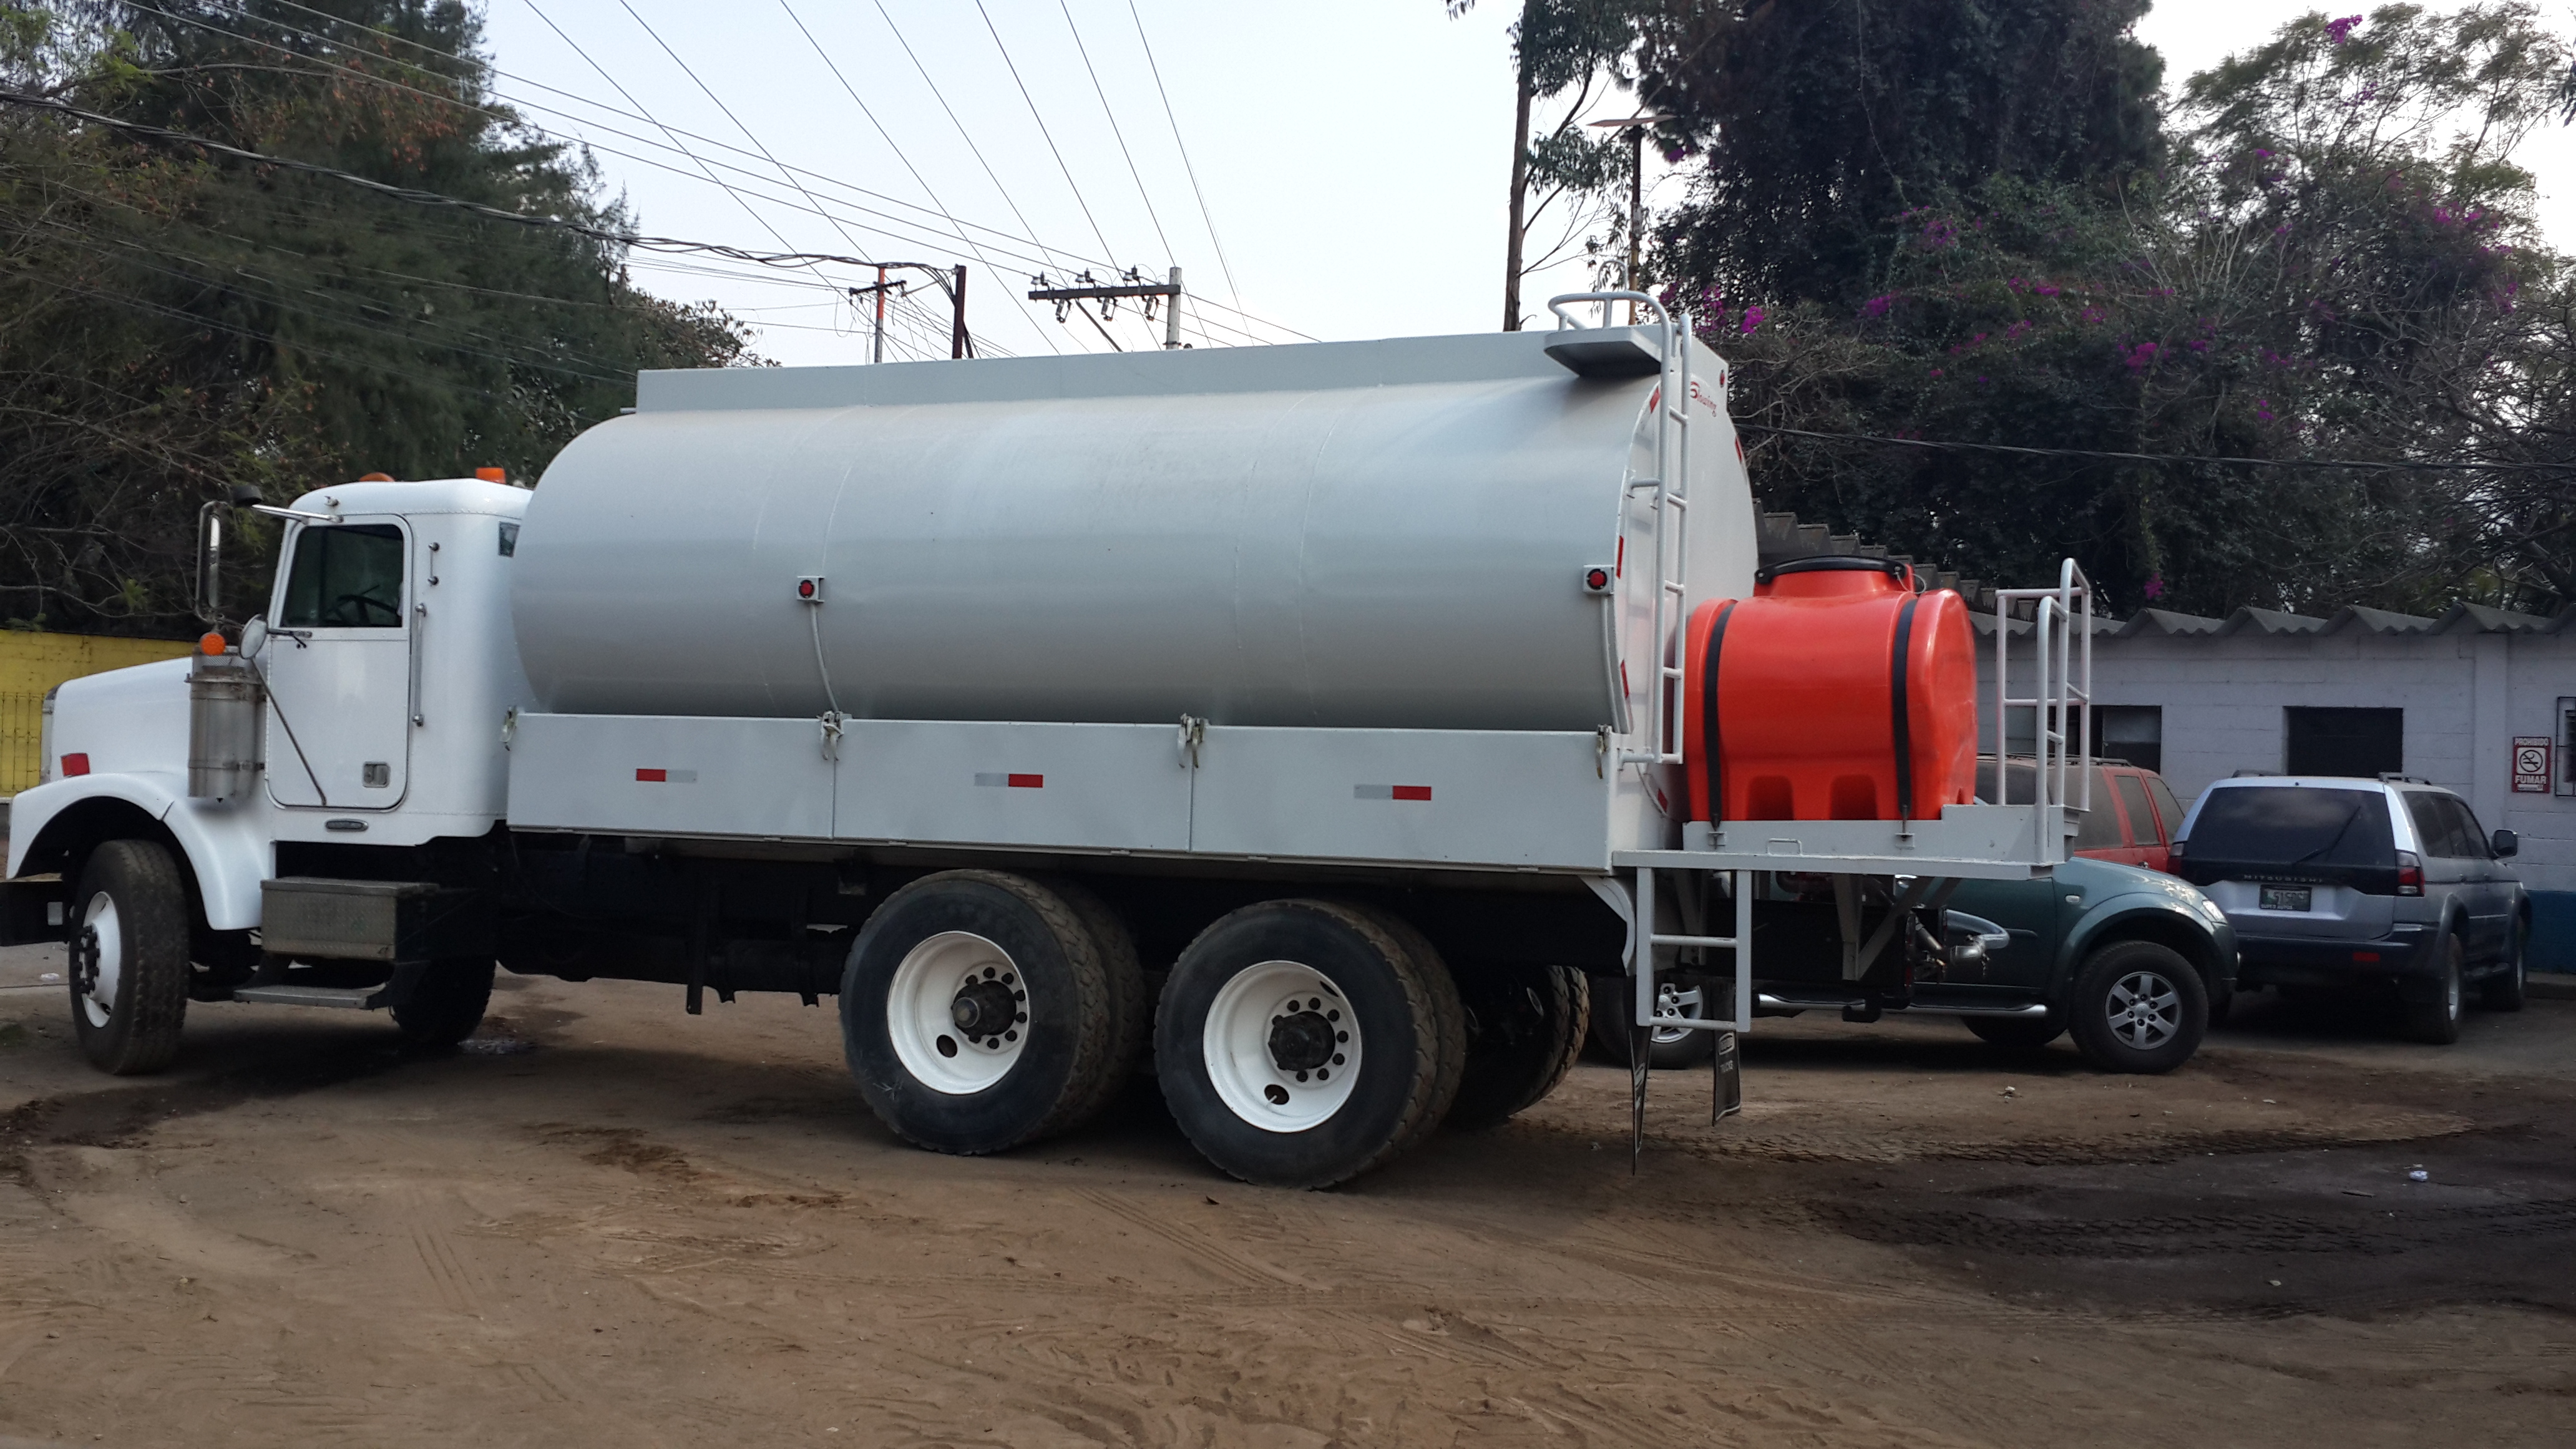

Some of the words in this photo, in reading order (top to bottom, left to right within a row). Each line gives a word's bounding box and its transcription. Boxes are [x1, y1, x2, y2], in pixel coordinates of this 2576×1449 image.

[2514, 738, 2549, 746] PROHIBIDO
[2514, 775, 2547, 784] FUMAR
[2243, 874, 2322, 883] MITSUBISHI
